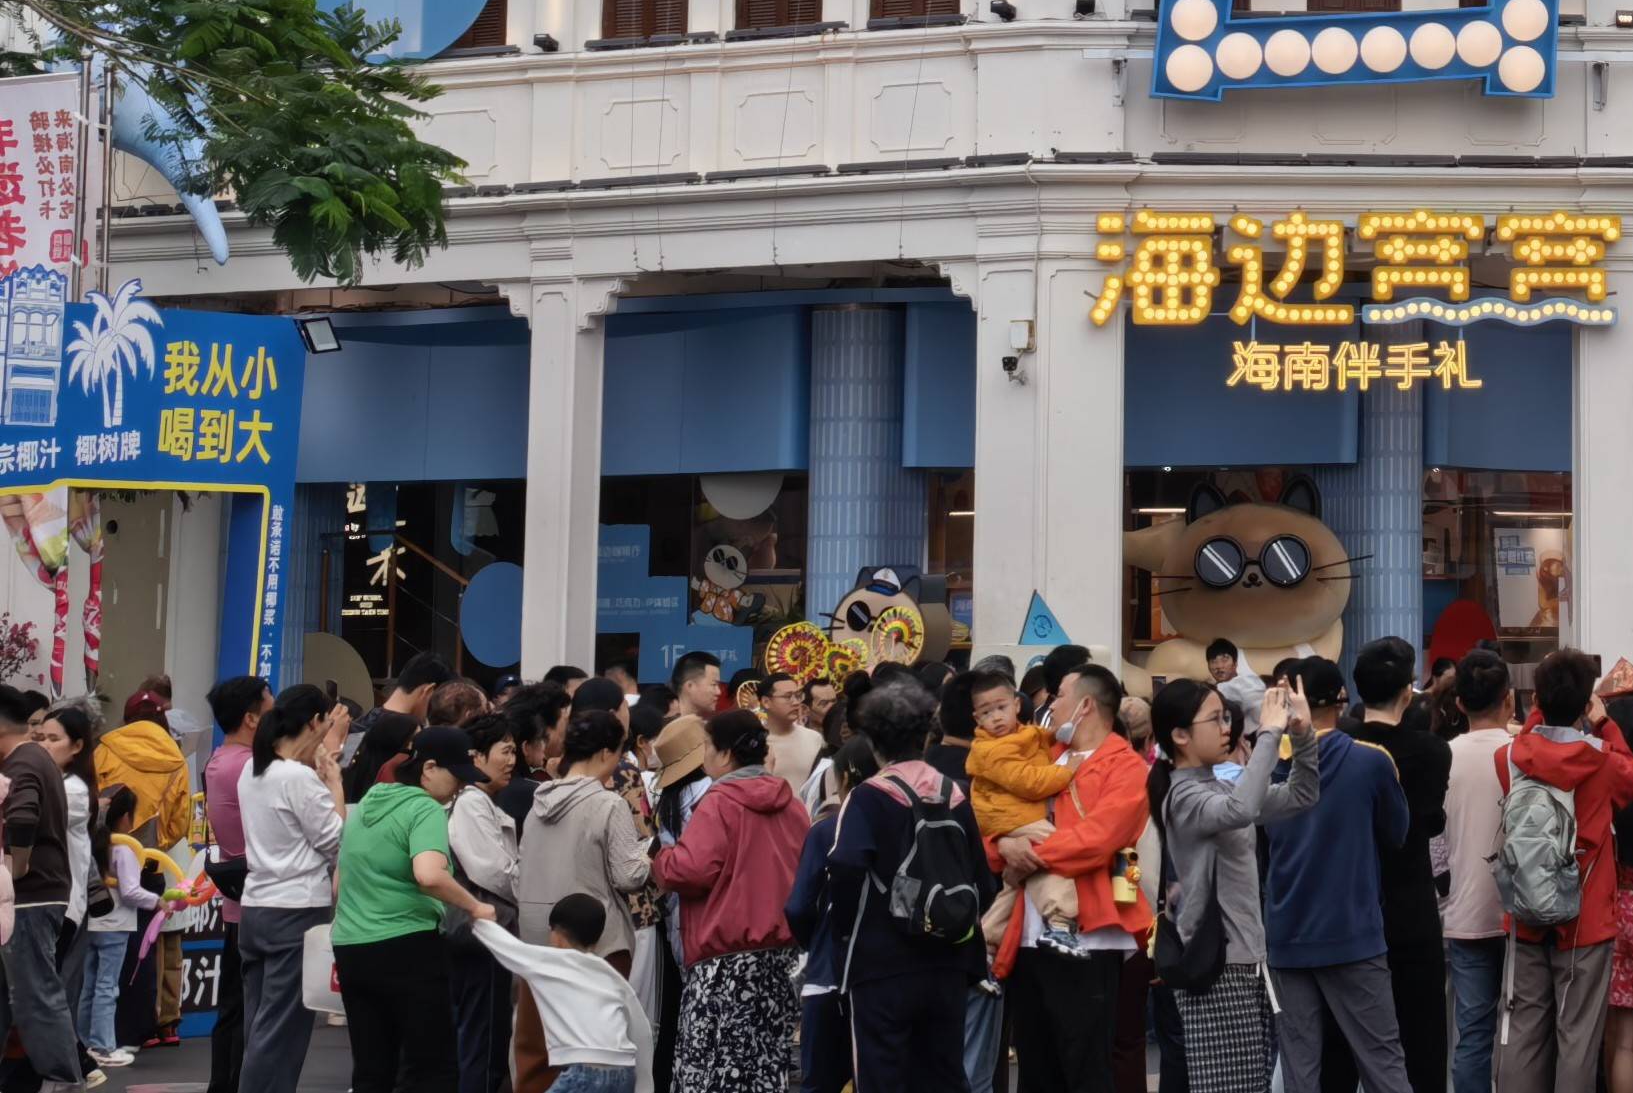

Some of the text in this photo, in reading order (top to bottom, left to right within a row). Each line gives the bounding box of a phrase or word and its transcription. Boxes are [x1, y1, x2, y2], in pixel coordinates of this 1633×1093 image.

[163, 340, 279, 400] 我从小
[1226, 340, 1482, 390] 海南伴手礼
[75, 429, 142, 466] 椰树牌
[157, 407, 273, 465] 喝到大
